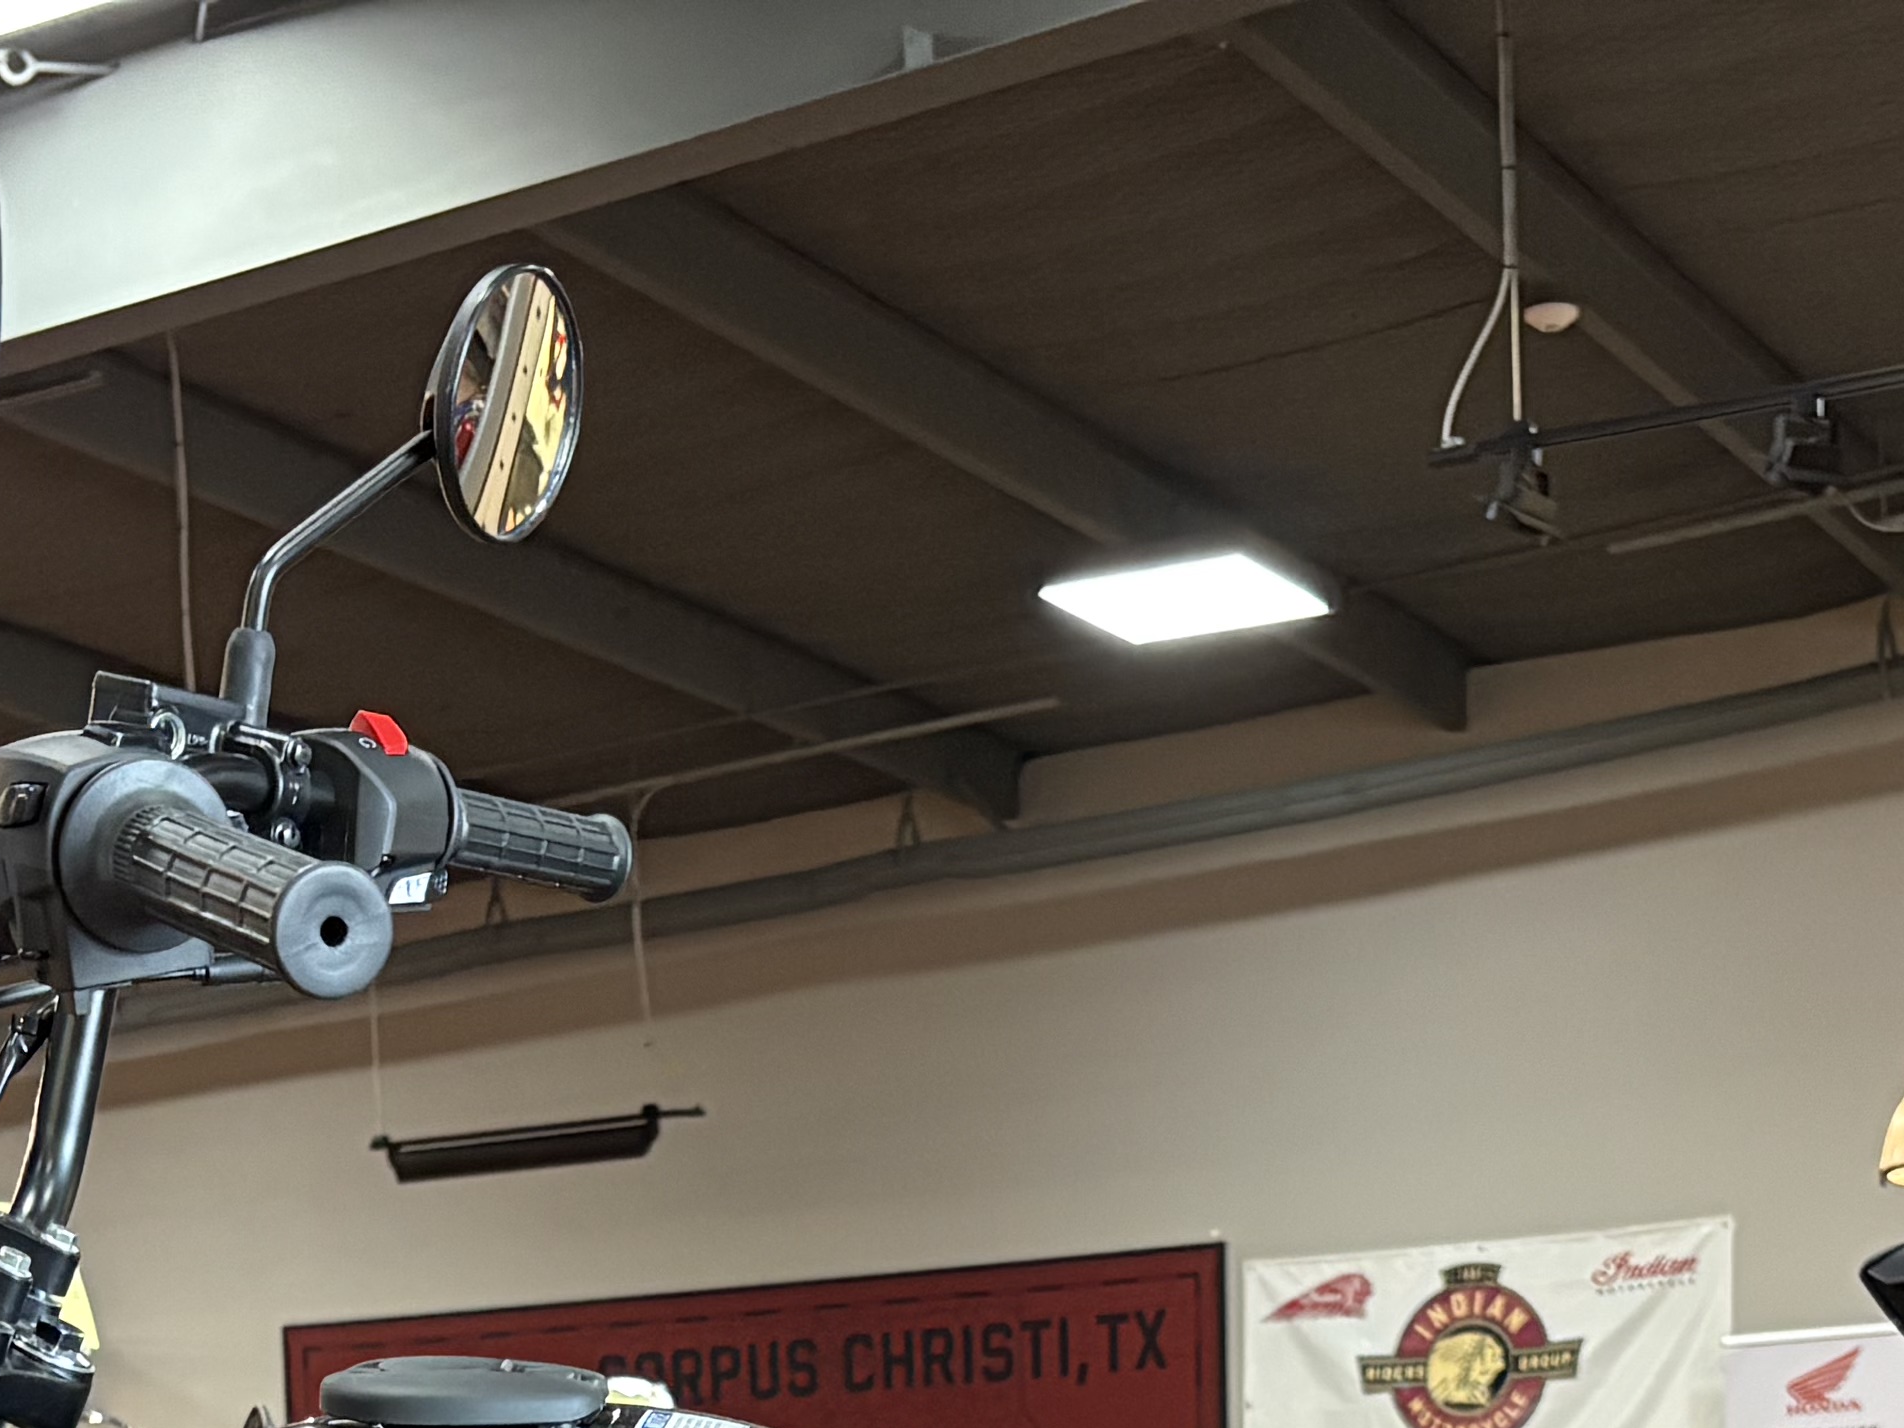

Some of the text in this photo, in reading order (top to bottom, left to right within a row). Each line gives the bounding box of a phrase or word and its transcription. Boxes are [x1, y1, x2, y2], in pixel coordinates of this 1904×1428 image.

[1591, 1251, 1698, 1286] Indian
[1414, 1291, 1530, 1341] INDIAN
[1786, 1401, 1862, 1417] HONDA
